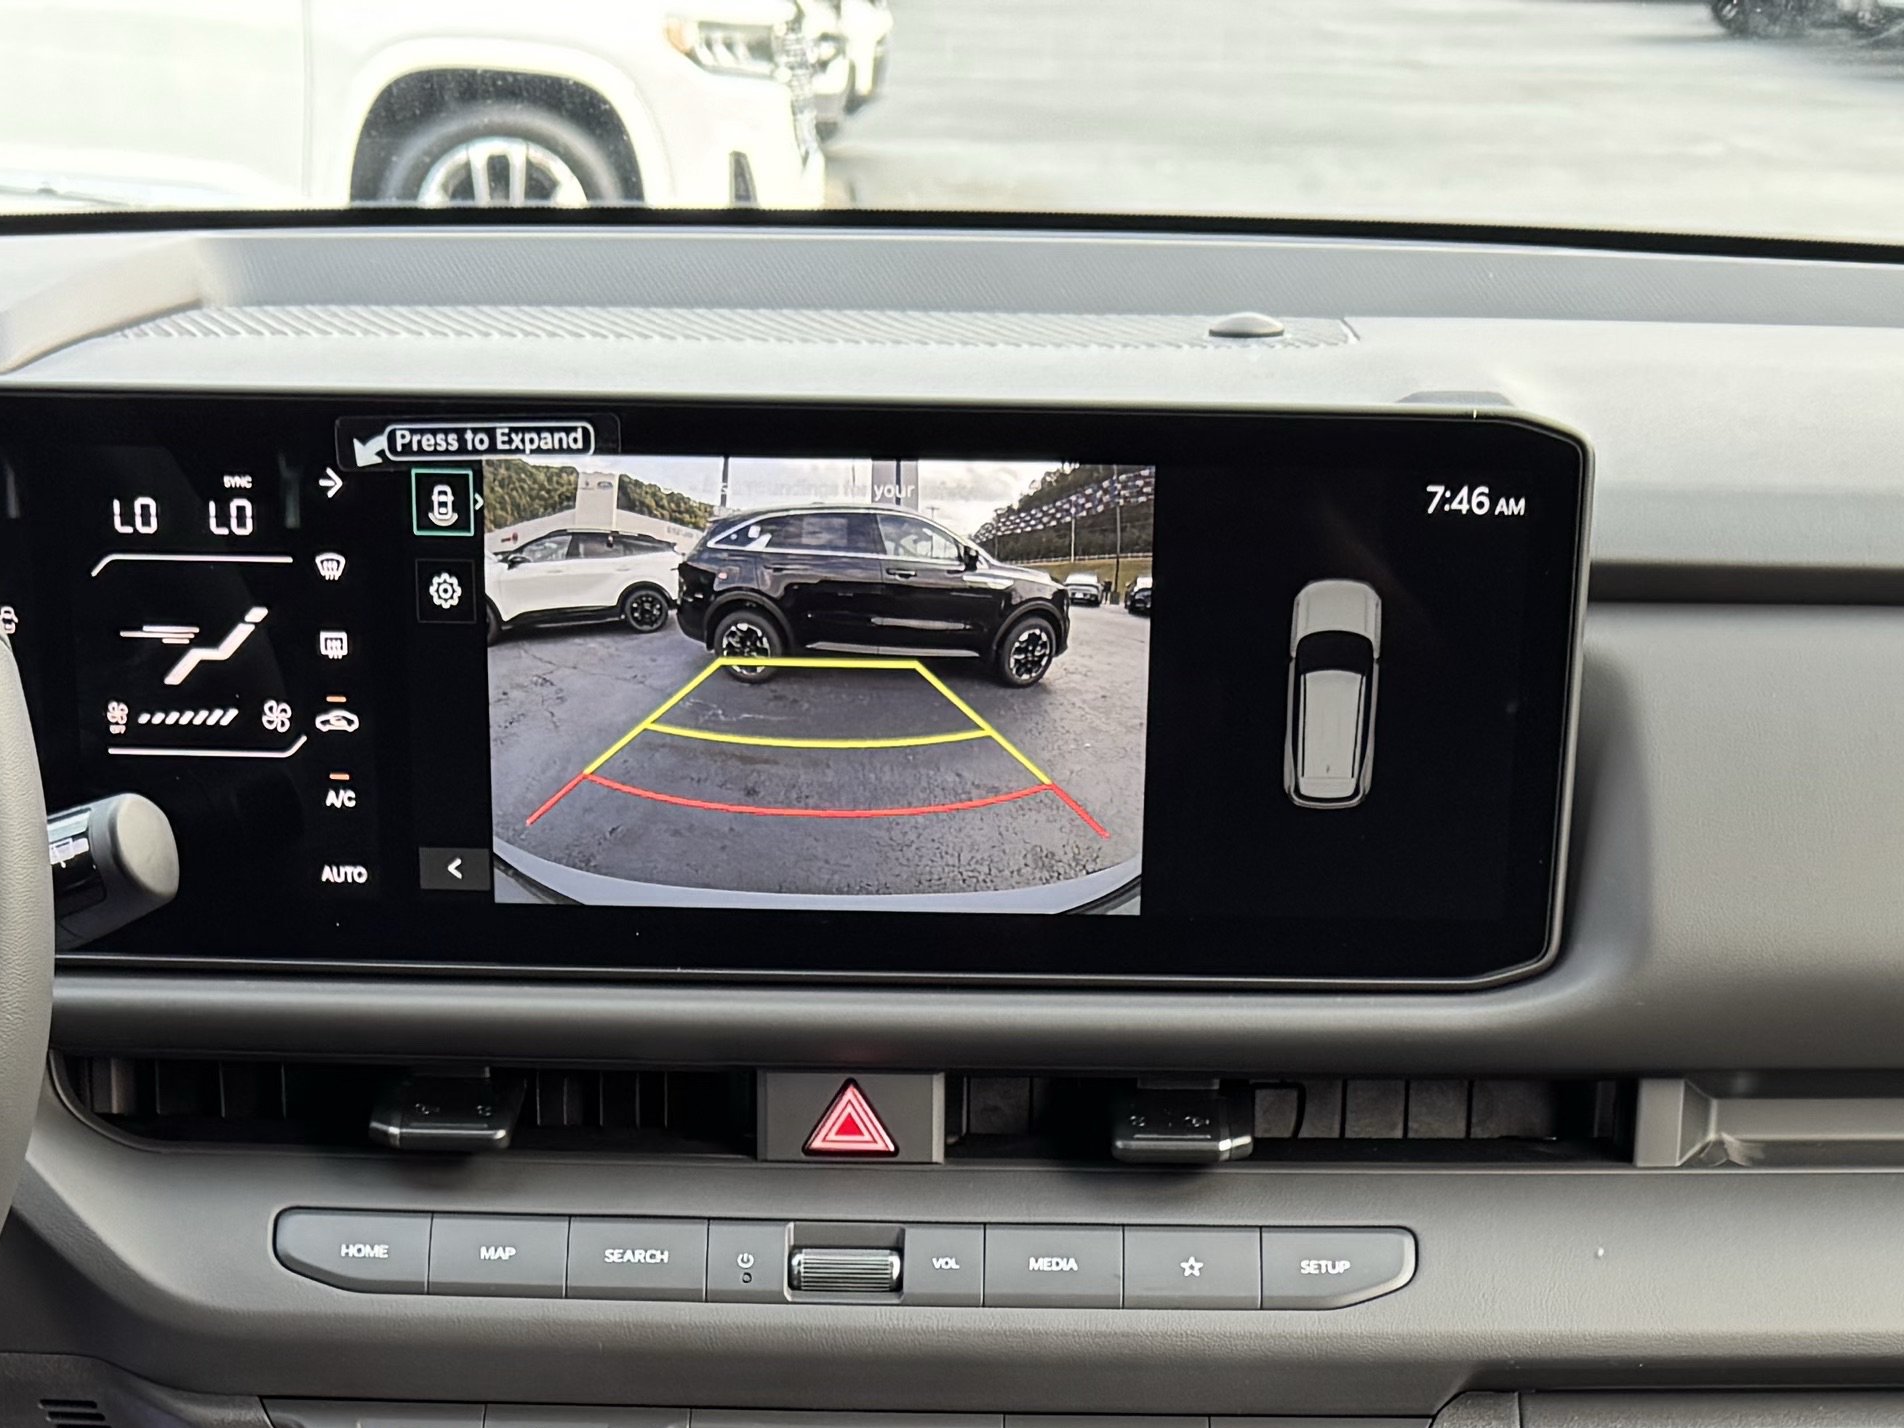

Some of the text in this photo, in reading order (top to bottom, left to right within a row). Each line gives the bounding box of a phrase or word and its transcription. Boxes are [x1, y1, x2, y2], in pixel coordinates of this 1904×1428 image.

[396, 426, 583, 455] Press to Expand
[223, 475, 252, 489] SYNC
[873, 482, 915, 500] your
[1426, 485, 1526, 516] 7:46 AM
[326, 789, 356, 808] A/C
[321, 864, 368, 883] AUTO
[340, 1243, 389, 1260] HOME
[480, 1246, 517, 1261] MAP
[604, 1248, 669, 1265] SEARCH
[932, 1257, 960, 1270] VOL
[1028, 1257, 1078, 1272] MEDIA
[1300, 1259, 1352, 1275] SETUP
